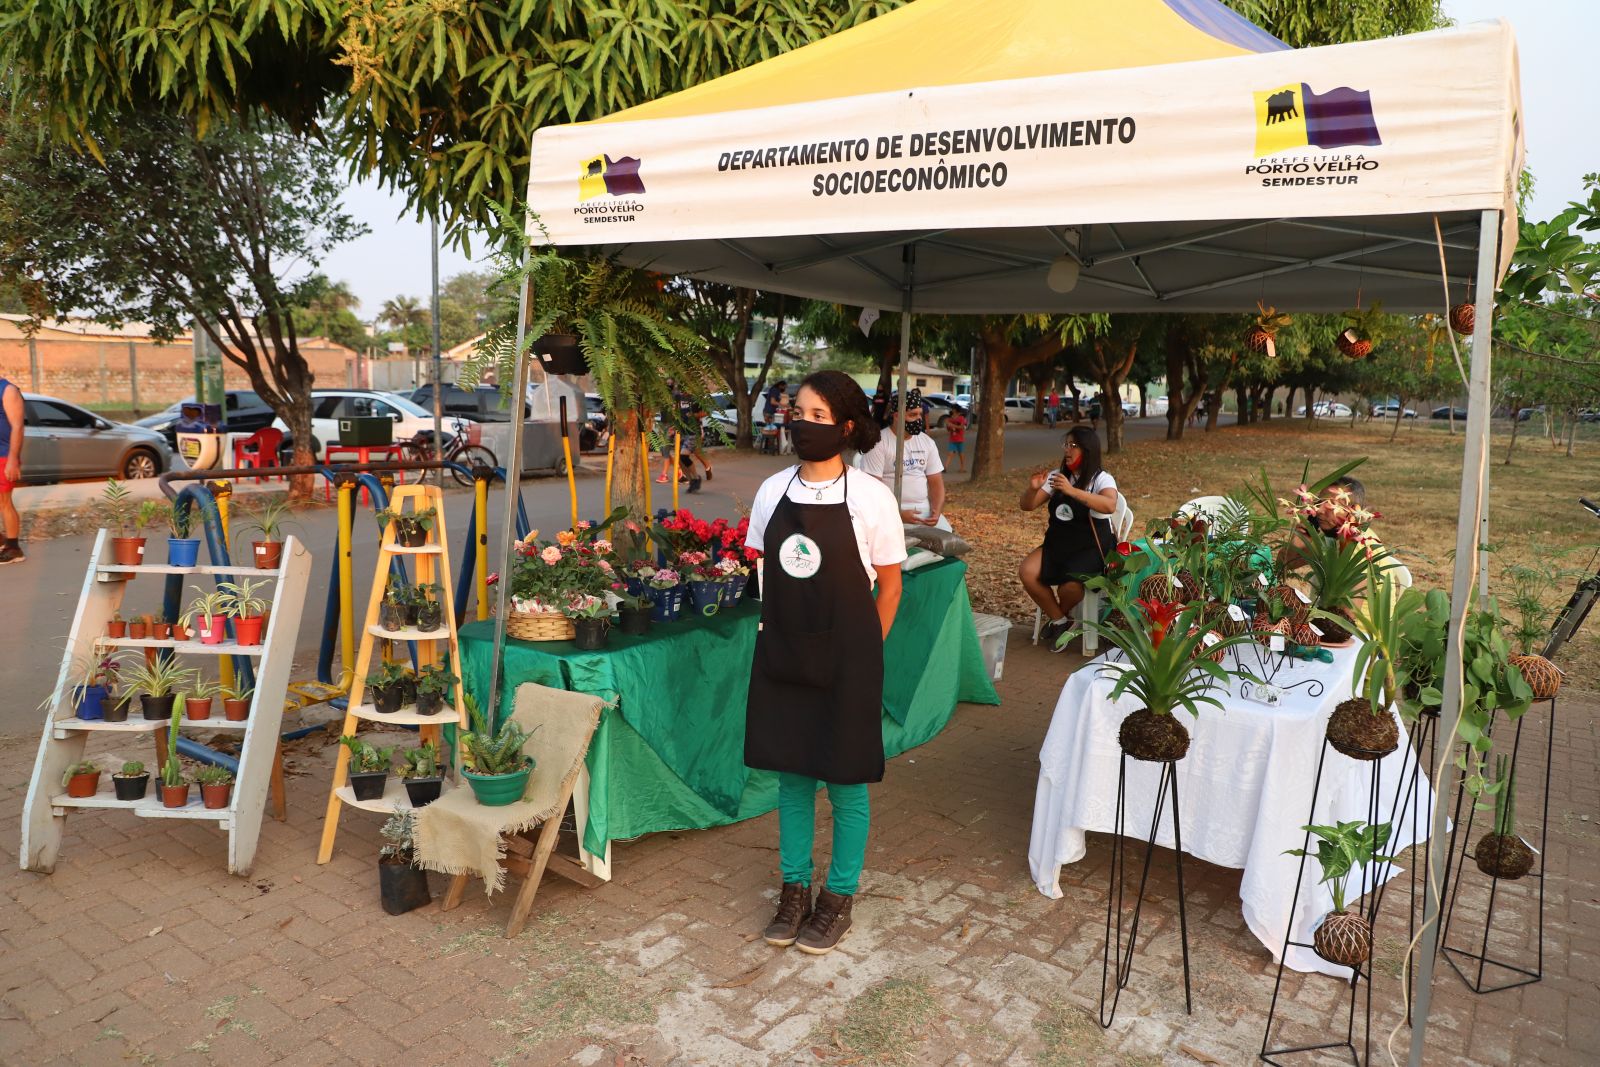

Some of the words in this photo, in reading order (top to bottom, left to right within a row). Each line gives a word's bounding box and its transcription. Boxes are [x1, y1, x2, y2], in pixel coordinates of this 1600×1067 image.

[717, 137, 870, 172] DEPARTAMENTO
[875, 135, 903, 159] DE
[909, 116, 1136, 157] DESENVOLVIMENTO
[1260, 154, 1366, 164] PREFEITURA
[1245, 163, 1309, 174] PORTO
[1313, 160, 1379, 172] VELHO
[812, 158, 1008, 197] SOCIOECONÔMICO
[1262, 176, 1358, 187] SEMDESTUR
[574, 206, 608, 214] PORTO
[610, 204, 644, 213] VELHO
[584, 215, 635, 224] SEMDESTUR
